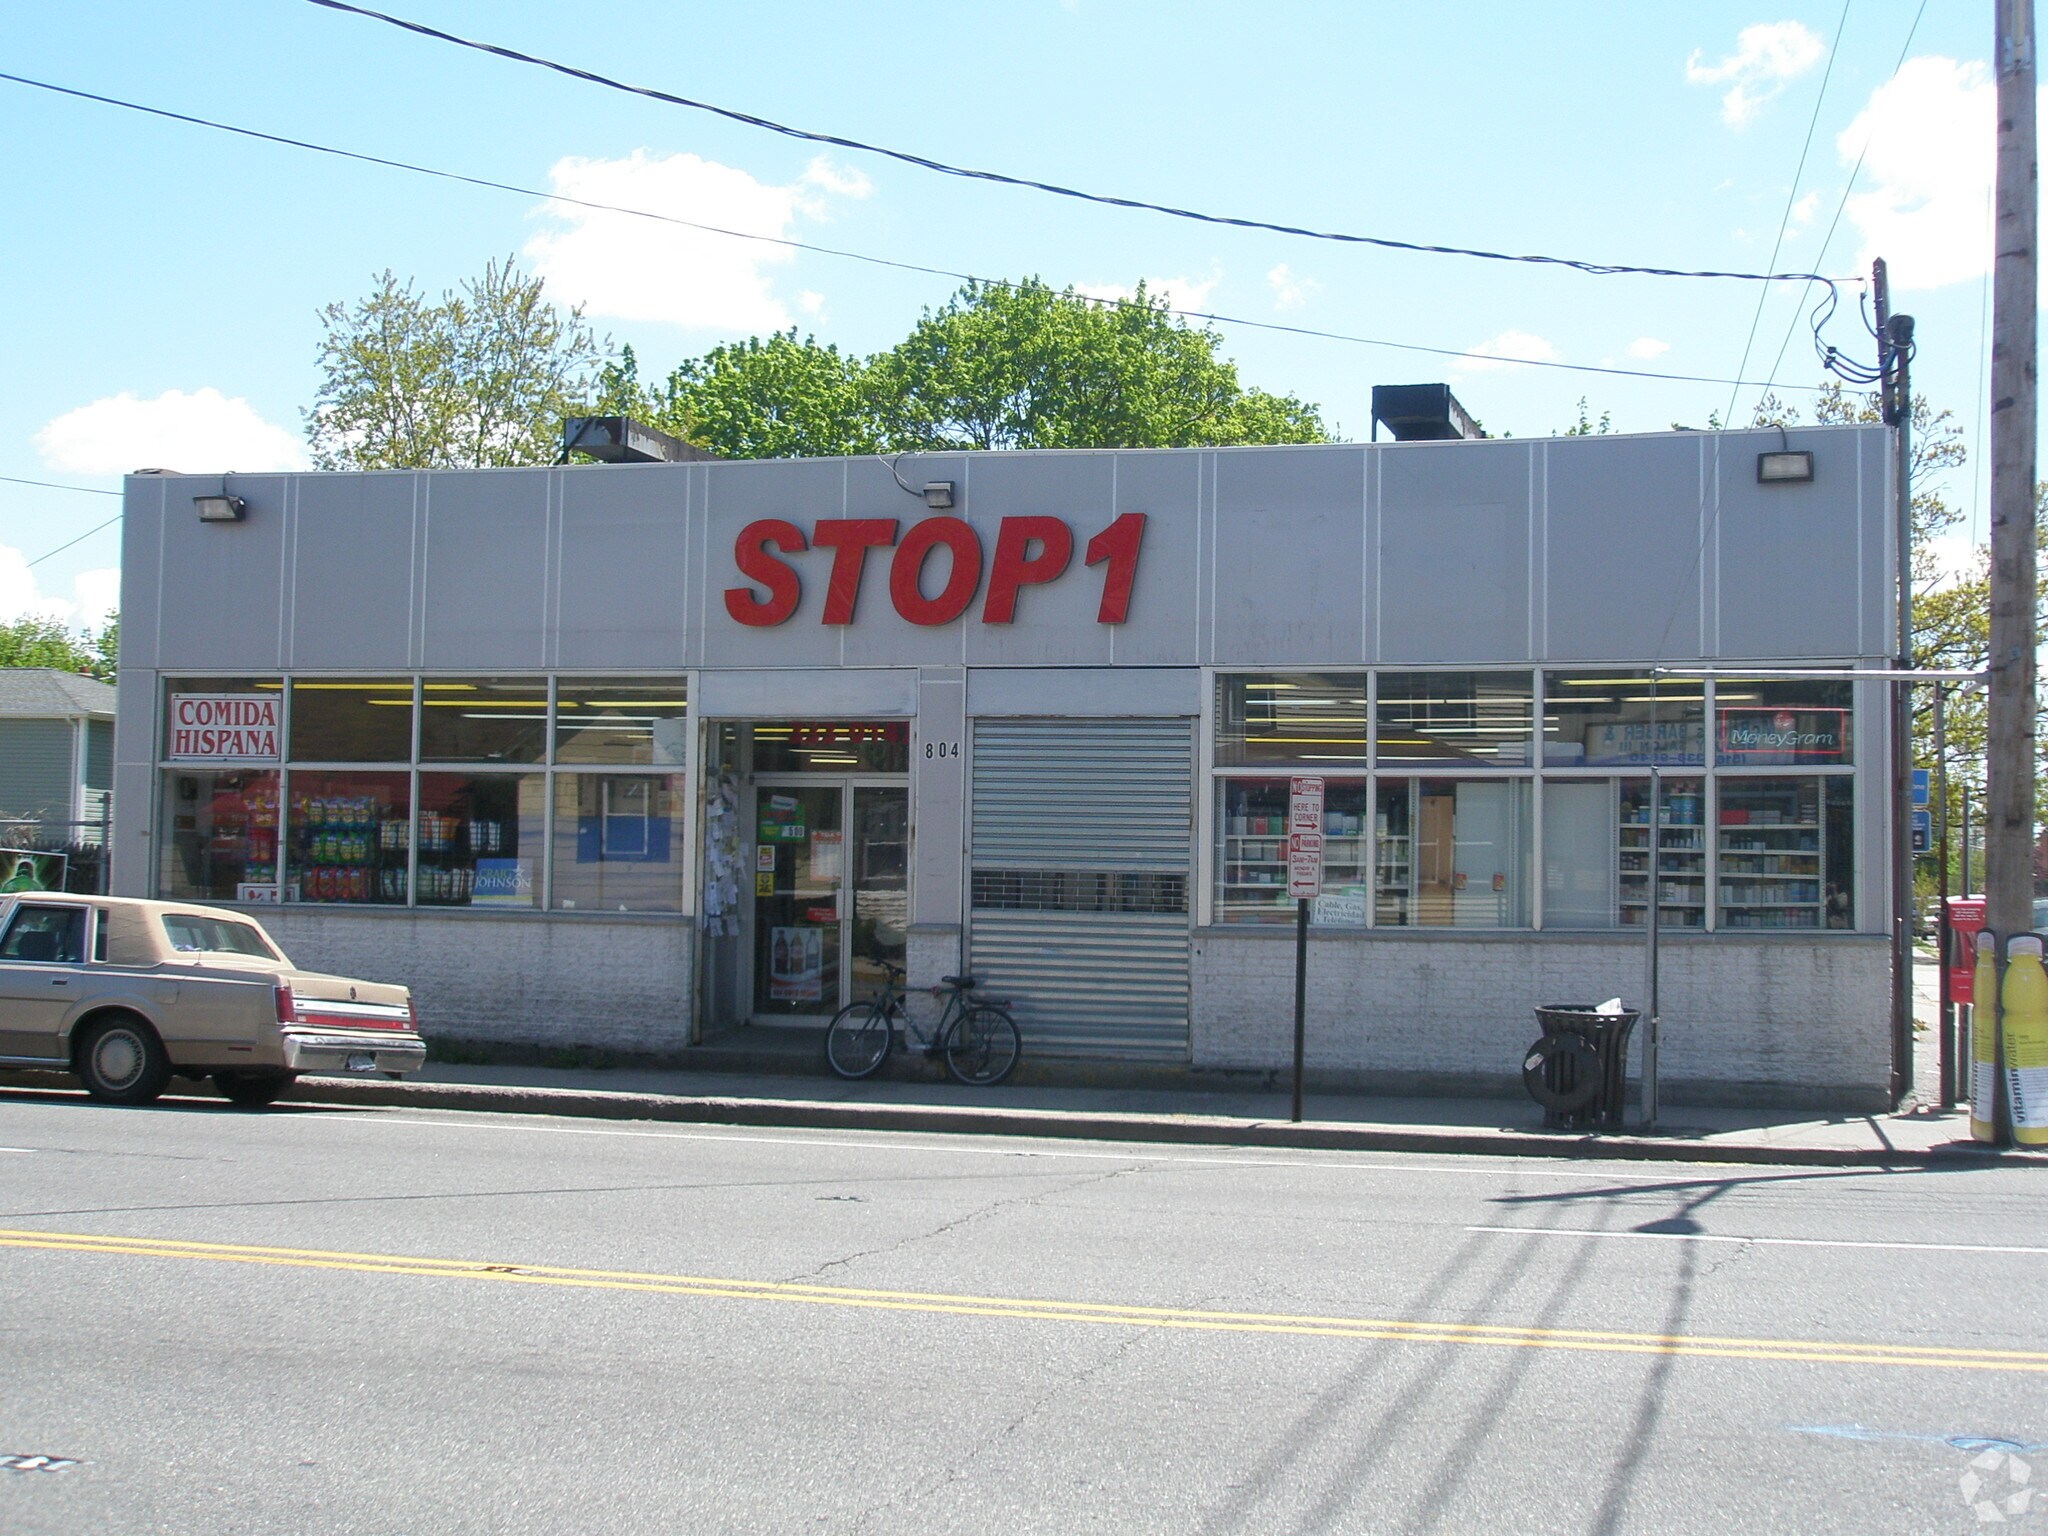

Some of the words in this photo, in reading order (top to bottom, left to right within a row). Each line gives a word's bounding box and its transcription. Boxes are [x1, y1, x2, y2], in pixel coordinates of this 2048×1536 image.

[178, 700, 276, 726] COMIDA
[174, 729, 276, 755] HISPANA
[1731, 729, 1834, 747] MoneyGram
[925, 741, 959, 760] 804
[1292, 781, 1302, 794] NO
[1301, 783, 1322, 793] STOPPING
[1293, 802, 1309, 812] HERE
[1312, 803, 1320, 812] TO
[1294, 812, 1318, 822] CORNER
[1291, 835, 1300, 850] NO
[1301, 839, 1319, 848] PARKING
[479, 868, 512, 879] CRAIG
[475, 876, 532, 889] JOHNSON
[1318, 900, 1344, 911] Cable,
[2006, 1032, 2025, 1124] vitaminwater
